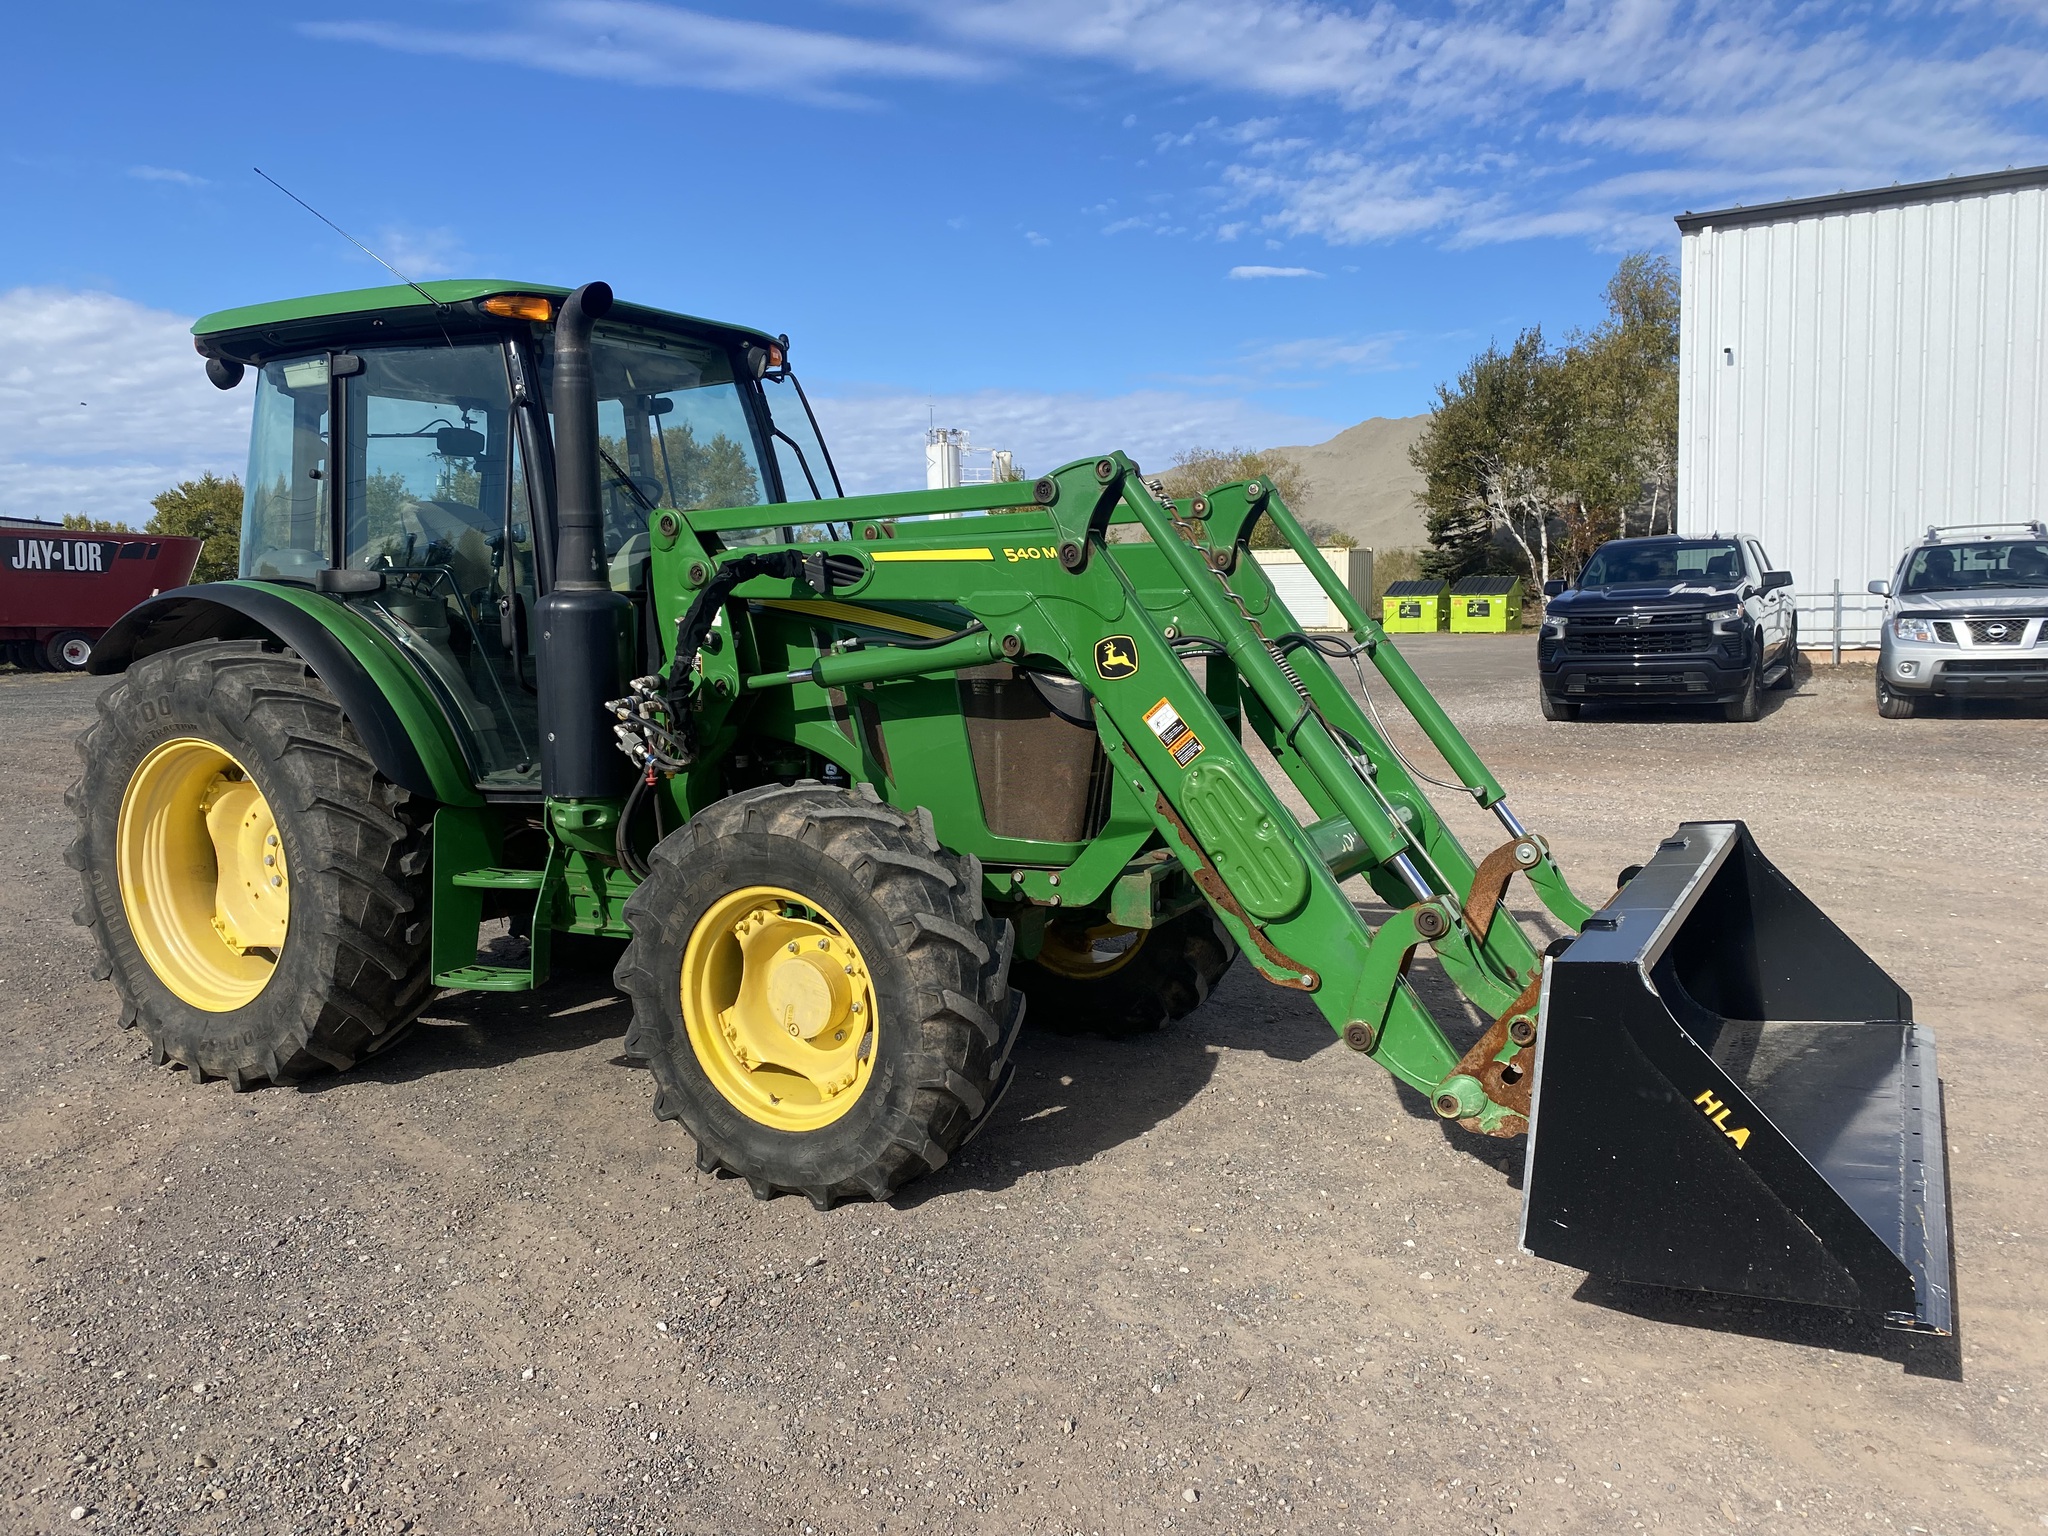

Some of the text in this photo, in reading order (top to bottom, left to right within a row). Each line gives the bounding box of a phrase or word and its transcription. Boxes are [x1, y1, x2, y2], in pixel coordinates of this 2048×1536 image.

[1002, 546, 1059, 563] 540 M
[813, 875, 891, 977] TRELLEBORG
[1693, 1089, 1751, 1151] HLA
